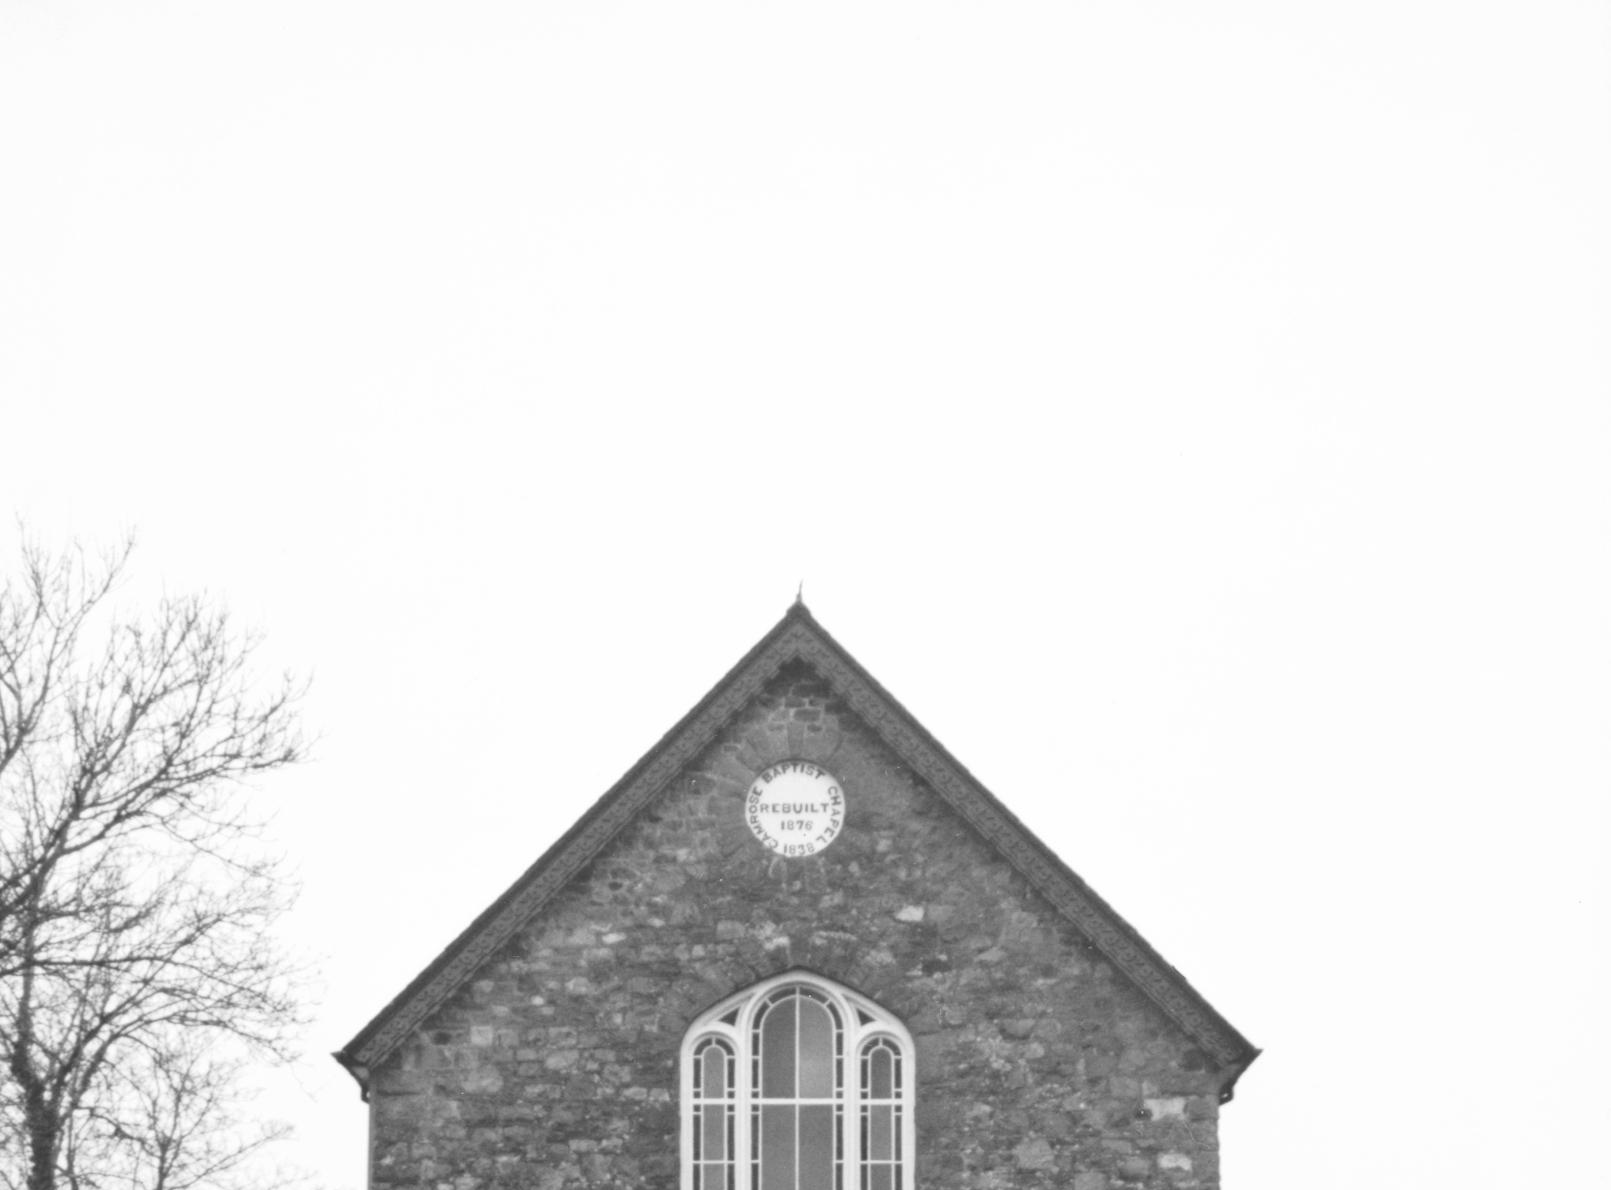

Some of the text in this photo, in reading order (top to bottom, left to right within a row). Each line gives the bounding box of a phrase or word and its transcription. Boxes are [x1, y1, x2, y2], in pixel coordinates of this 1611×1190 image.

[760, 803, 830, 814] REBUILT
[761, 763, 826, 784] BAPTIST
[816, 786, 841, 843] CHAPEL
